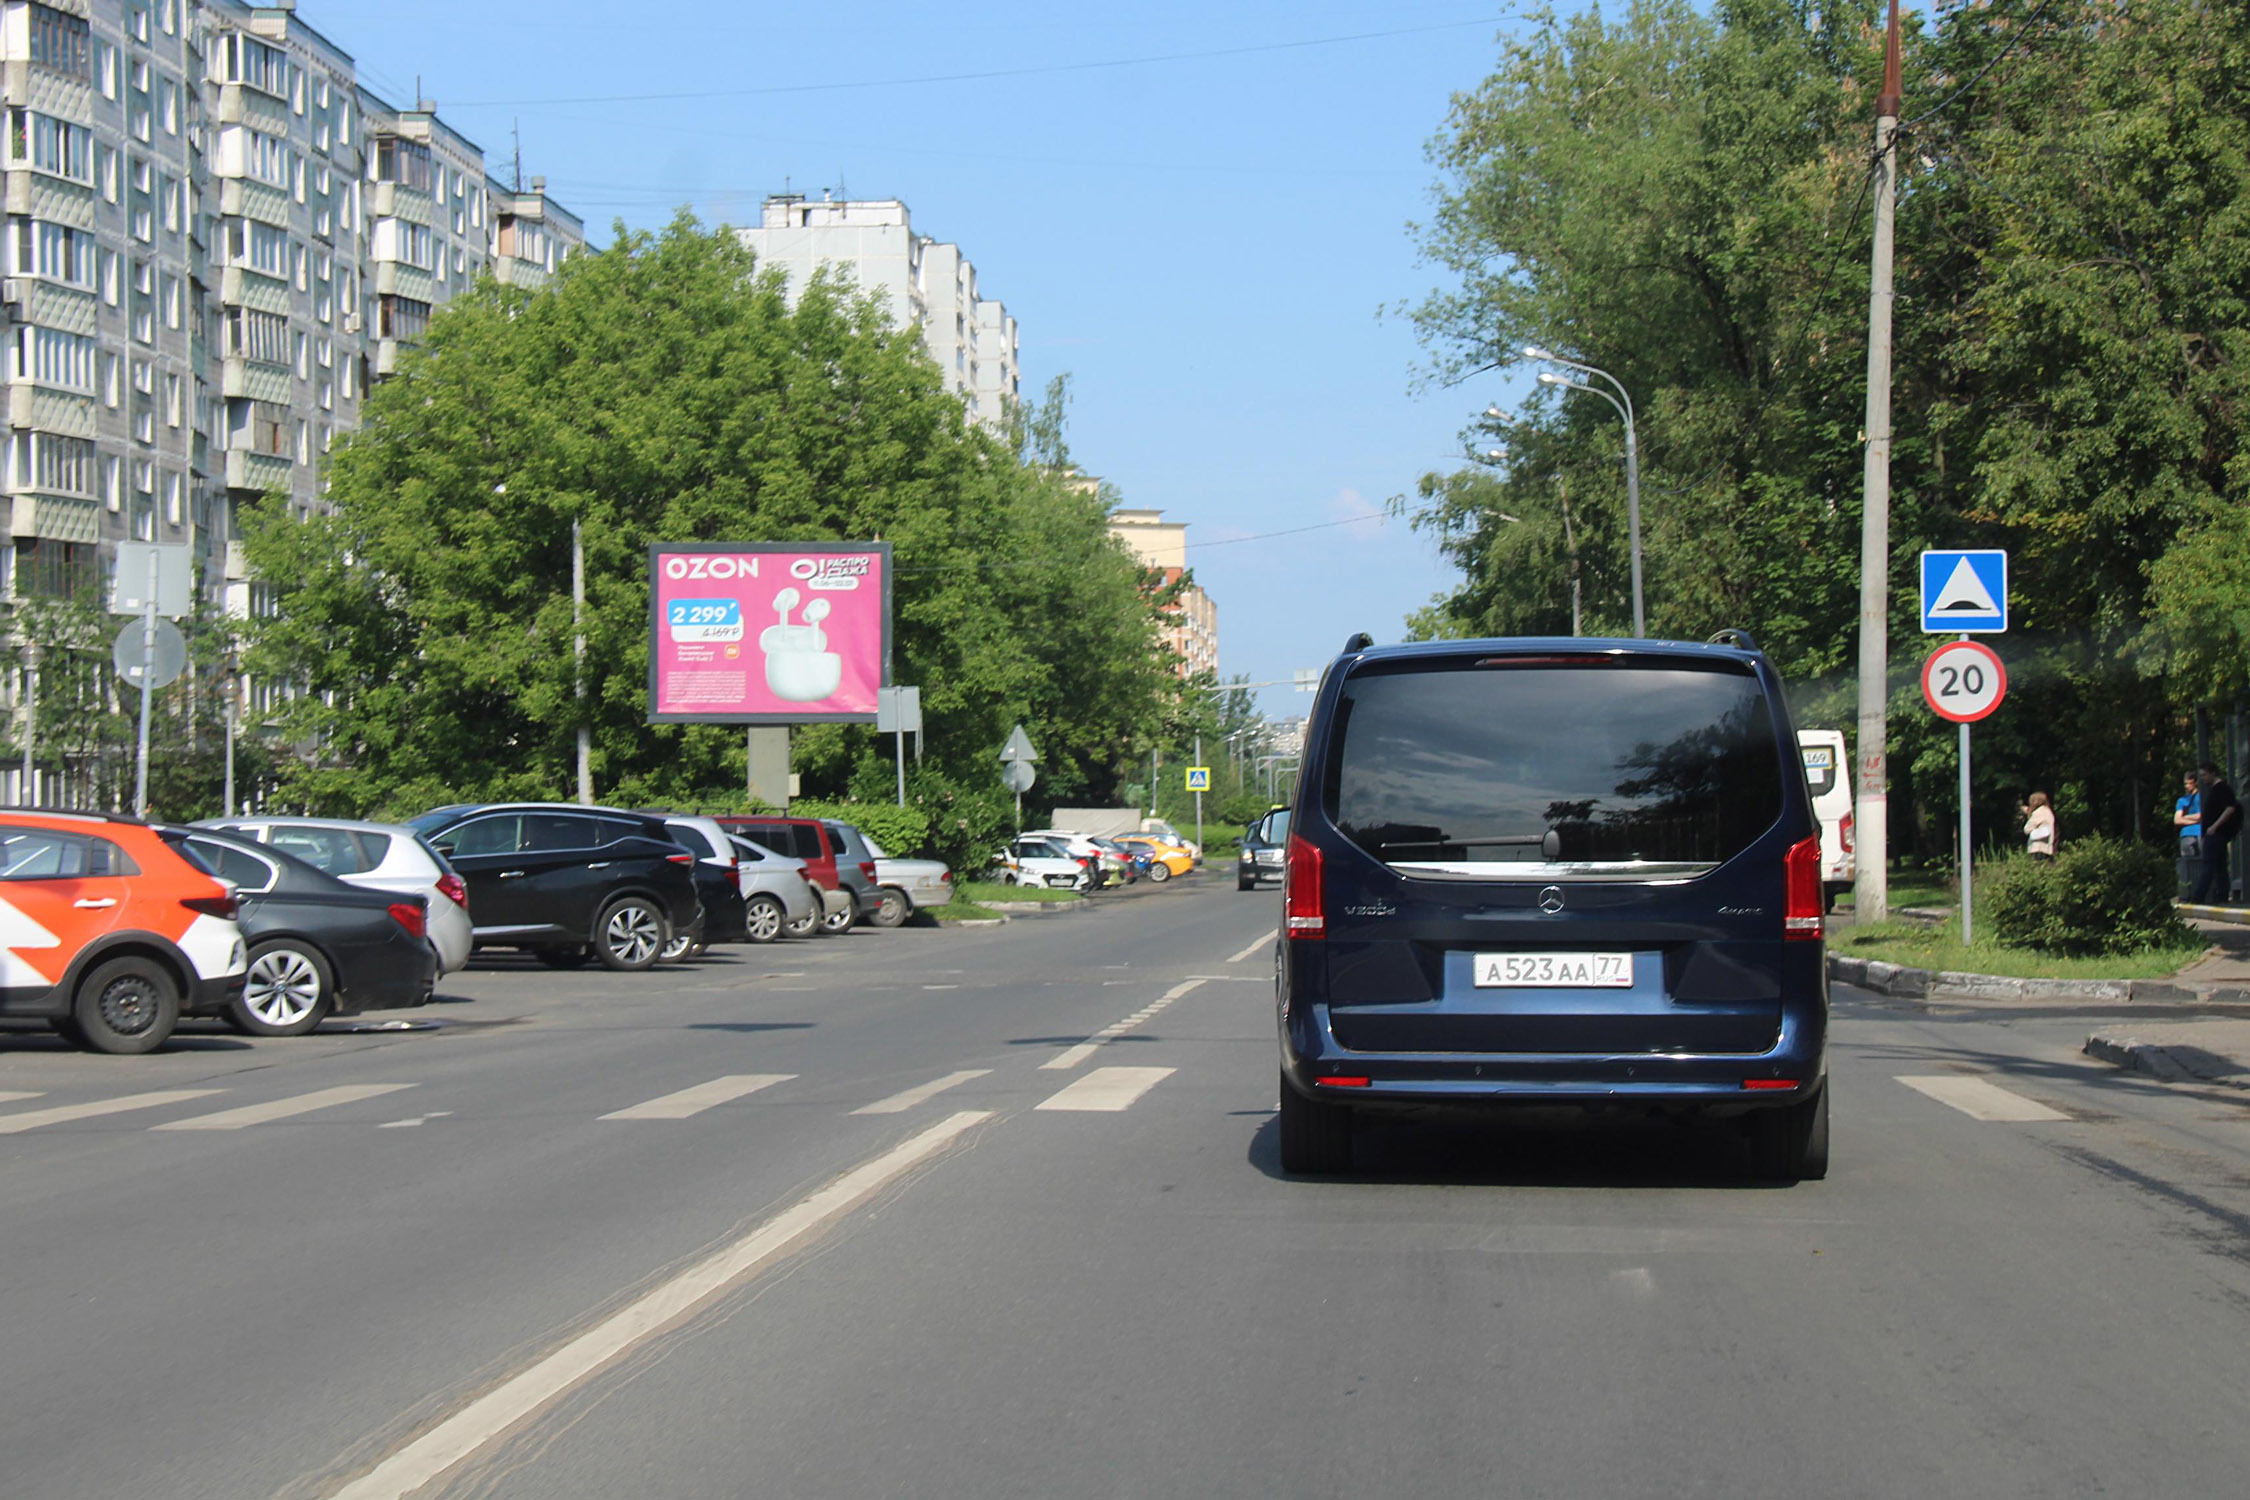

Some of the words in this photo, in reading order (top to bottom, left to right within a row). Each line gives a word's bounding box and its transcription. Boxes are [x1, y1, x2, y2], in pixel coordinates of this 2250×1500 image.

[666, 557, 759, 580] OZON
[671, 606, 686, 623] 2
[1939, 663, 1984, 696] 20
[1806, 752, 1827, 764] 169
[1598, 956, 1623, 975] 77
